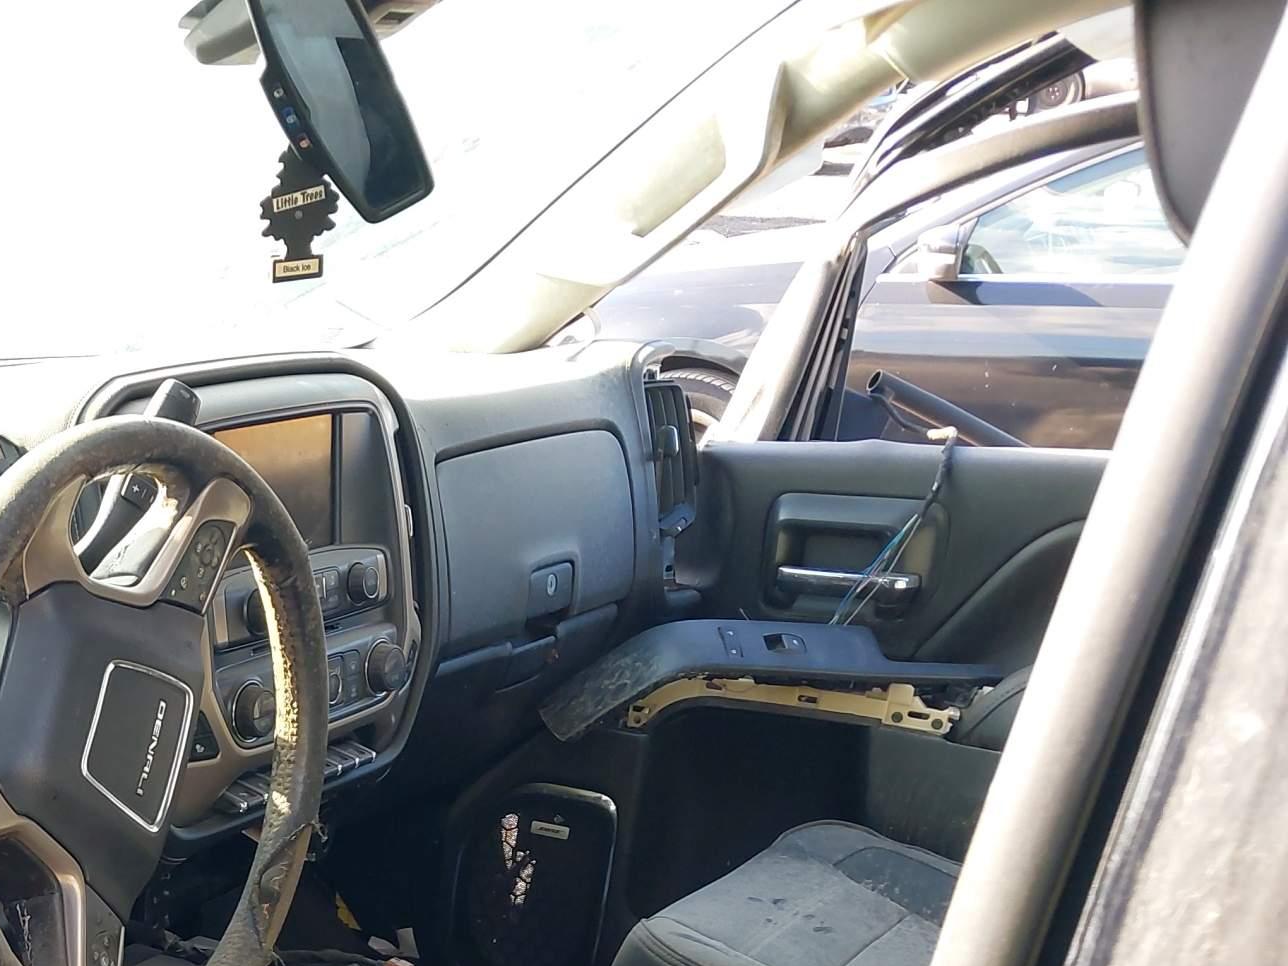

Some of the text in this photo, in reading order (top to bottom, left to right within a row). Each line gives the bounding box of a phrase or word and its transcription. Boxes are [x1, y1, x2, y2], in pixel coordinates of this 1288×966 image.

[275, 189, 323, 210] Little Trees
[282, 263, 312, 274] Black Ice
[135, 700, 168, 797] DENALI
